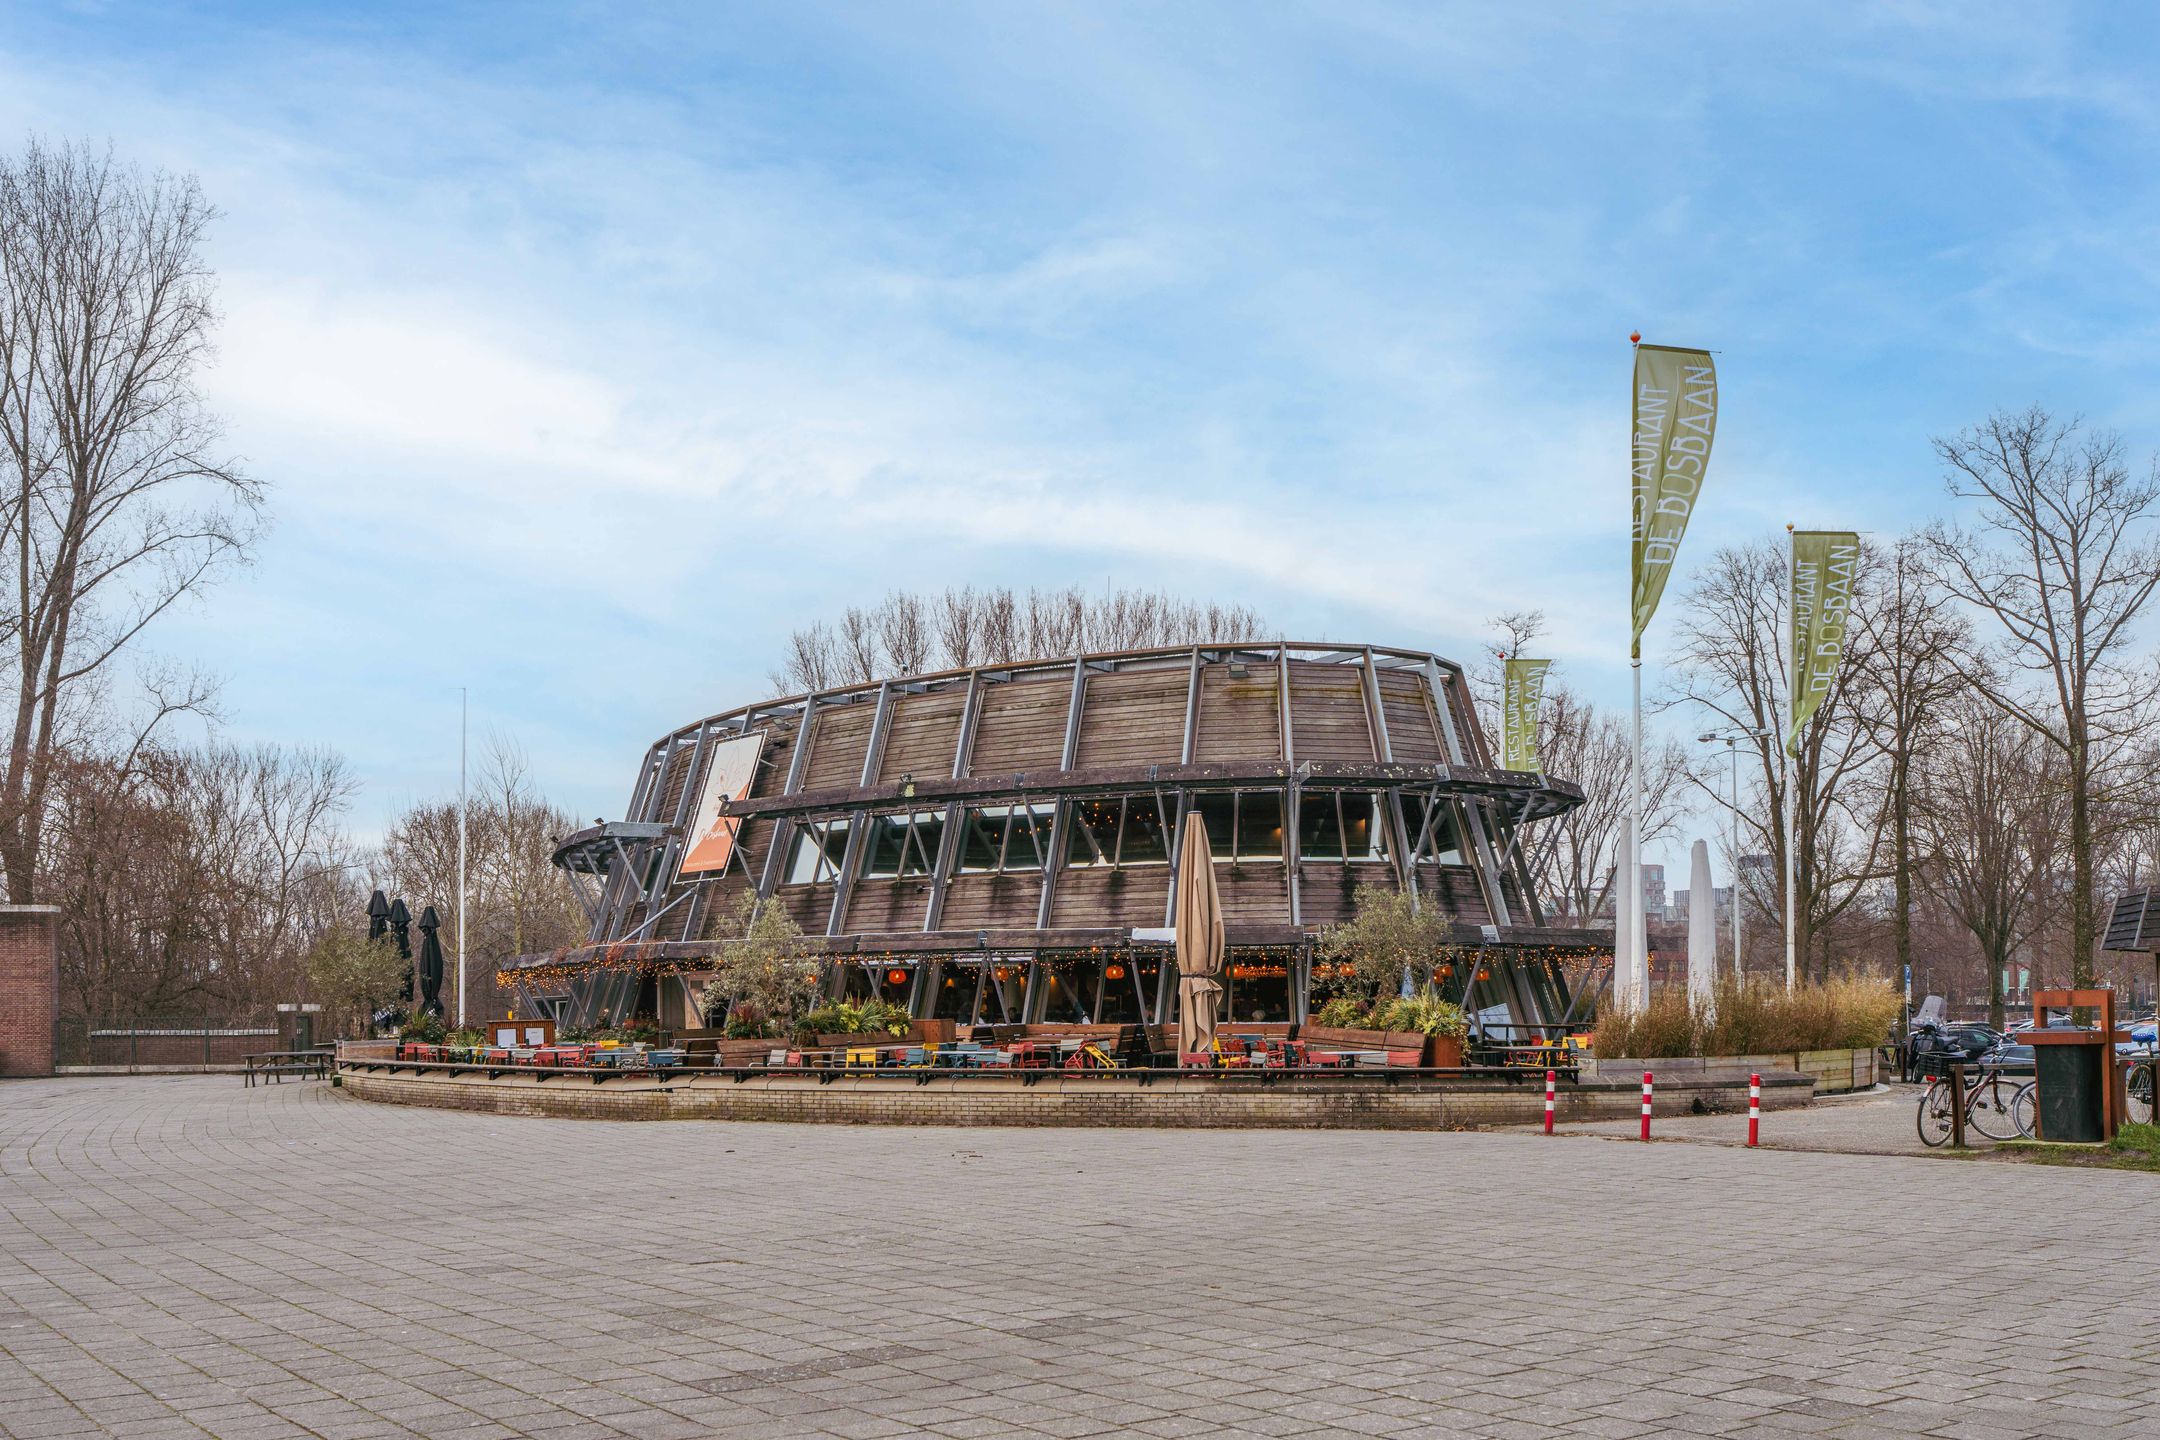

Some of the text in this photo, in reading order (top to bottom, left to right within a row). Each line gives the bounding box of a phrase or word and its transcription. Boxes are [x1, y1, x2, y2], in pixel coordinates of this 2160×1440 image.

[1644, 365, 1715, 564] DE BOSBAAN
[1811, 545, 1858, 692] DE BOSBAAN
[1508, 679, 1520, 762] RESTAURANT
